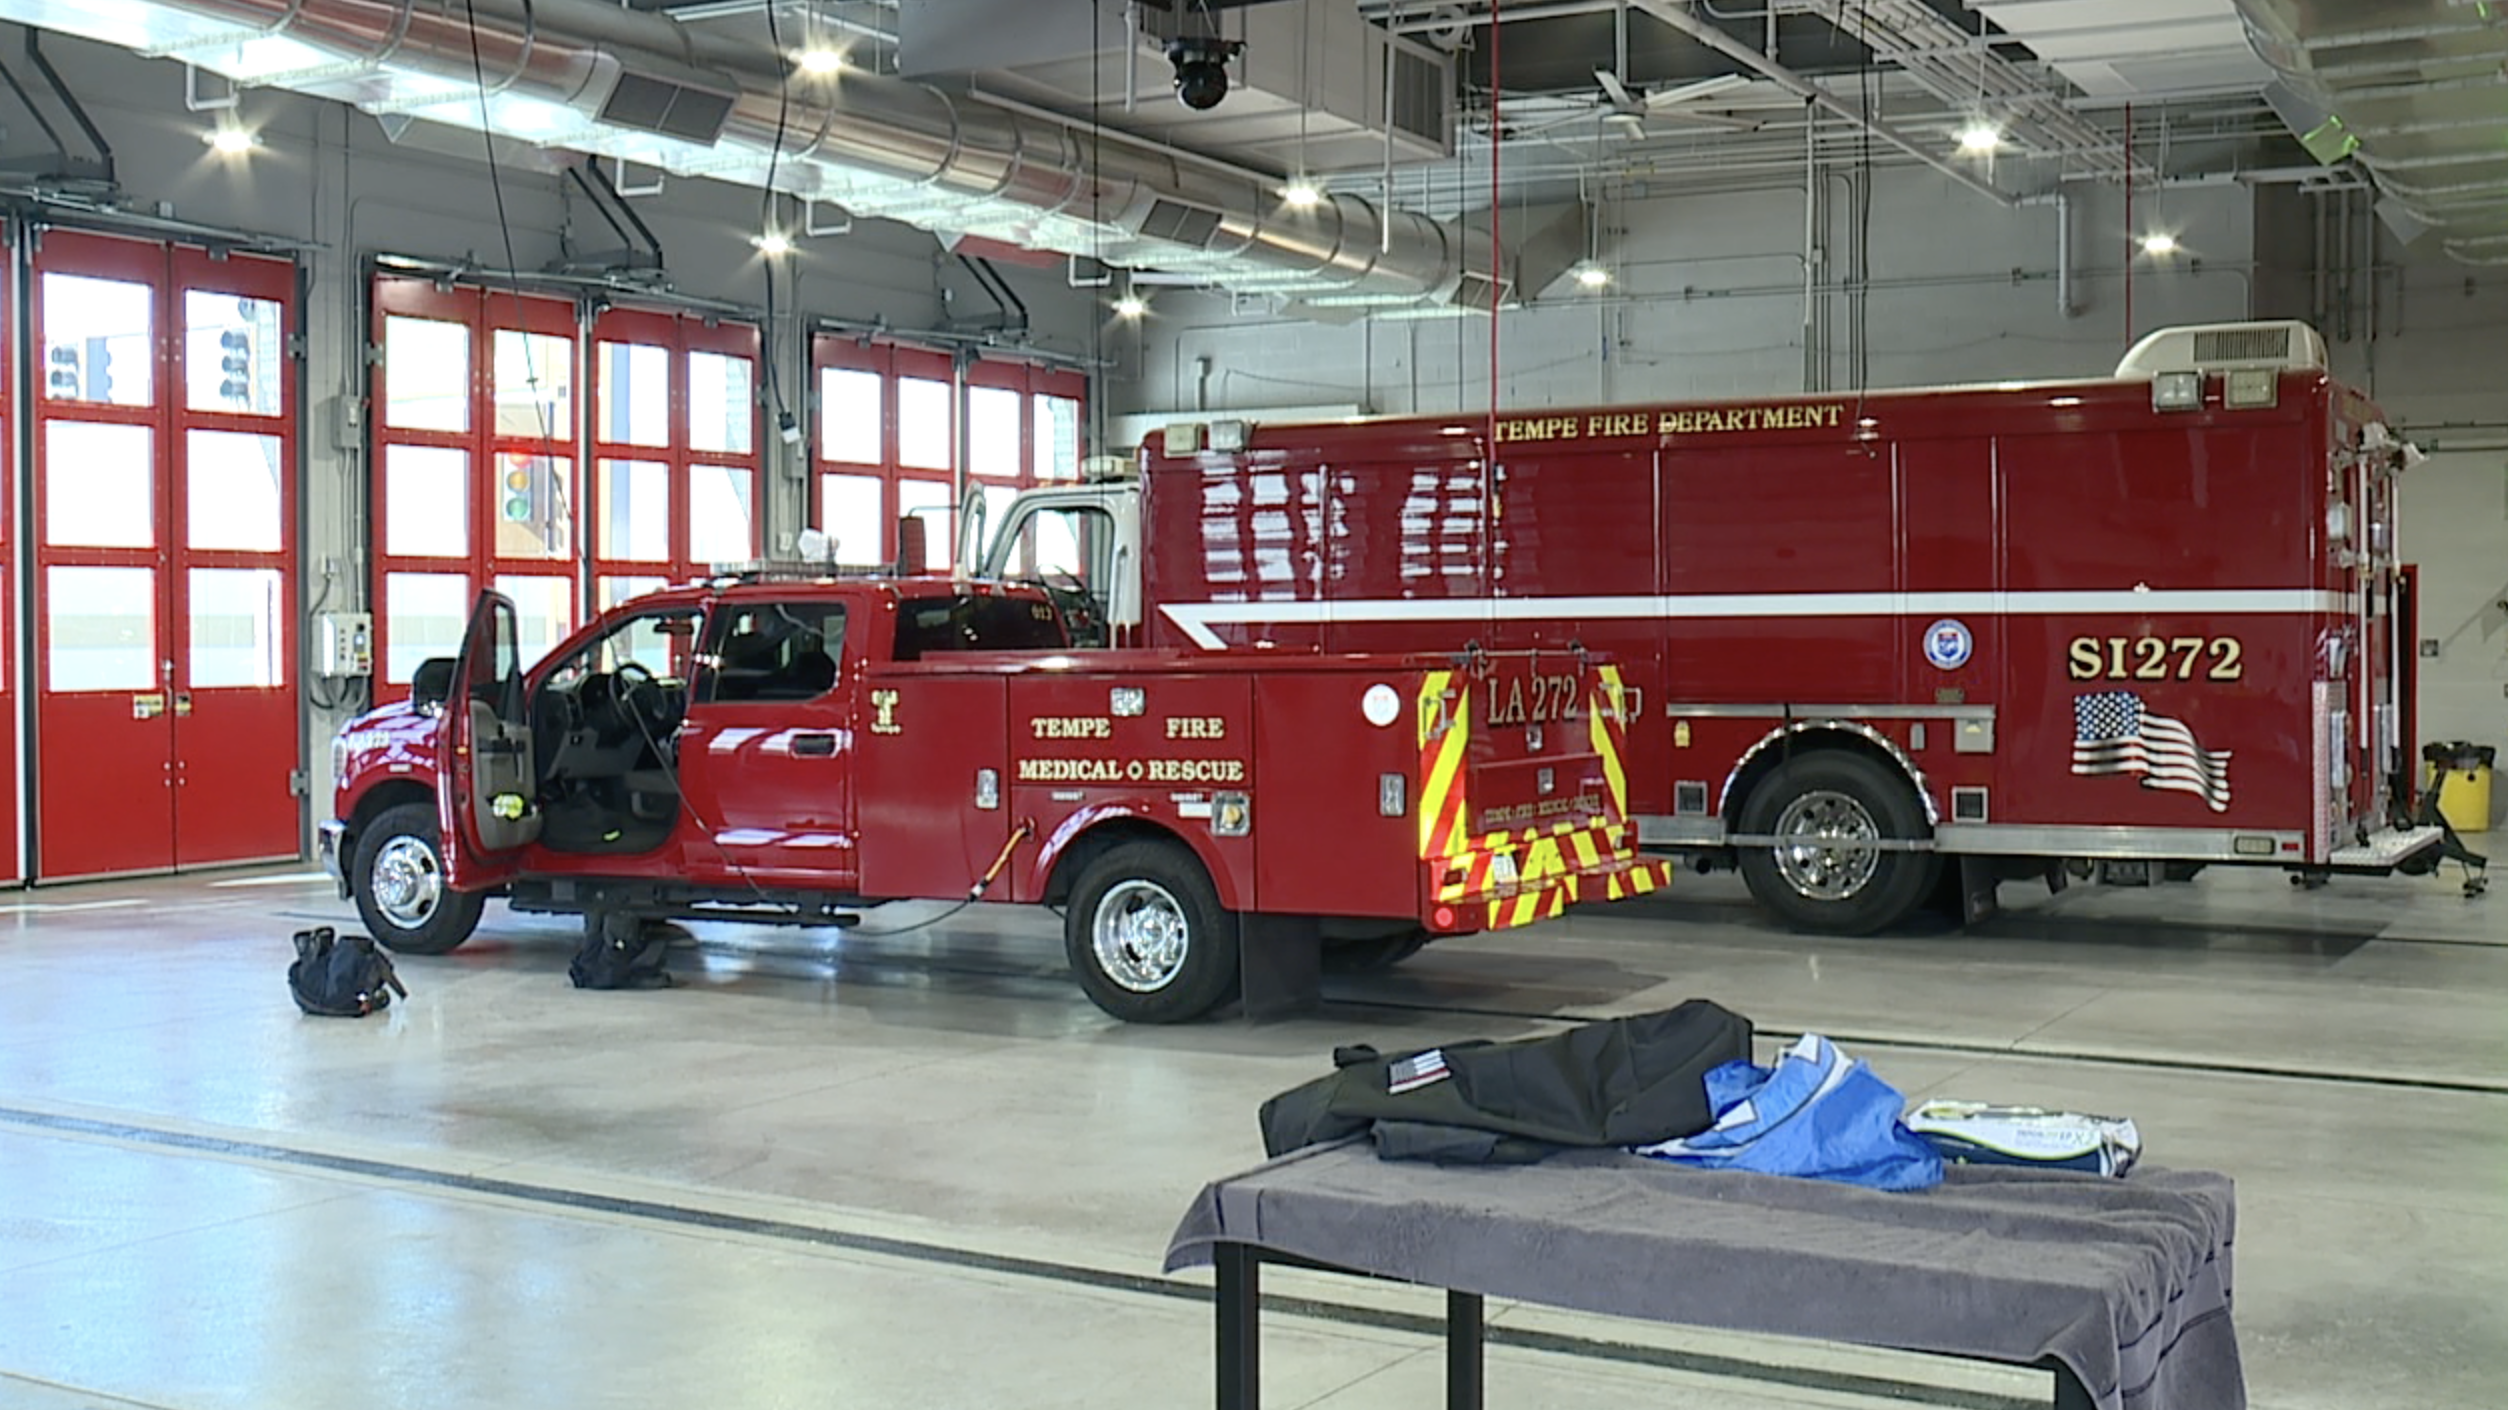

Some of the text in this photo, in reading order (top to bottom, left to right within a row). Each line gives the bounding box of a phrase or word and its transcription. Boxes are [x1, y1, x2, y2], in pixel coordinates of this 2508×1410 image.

[1493, 404, 1845, 442] TEMPE FIRE DEPARTMENT
[2069, 637, 2243, 680] SI272
[1488, 675, 1578, 724] LA 272
[1031, 717, 1224, 739] TEMPE FIRE
[1018, 759, 1244, 781] MEDICAL RESCUE
